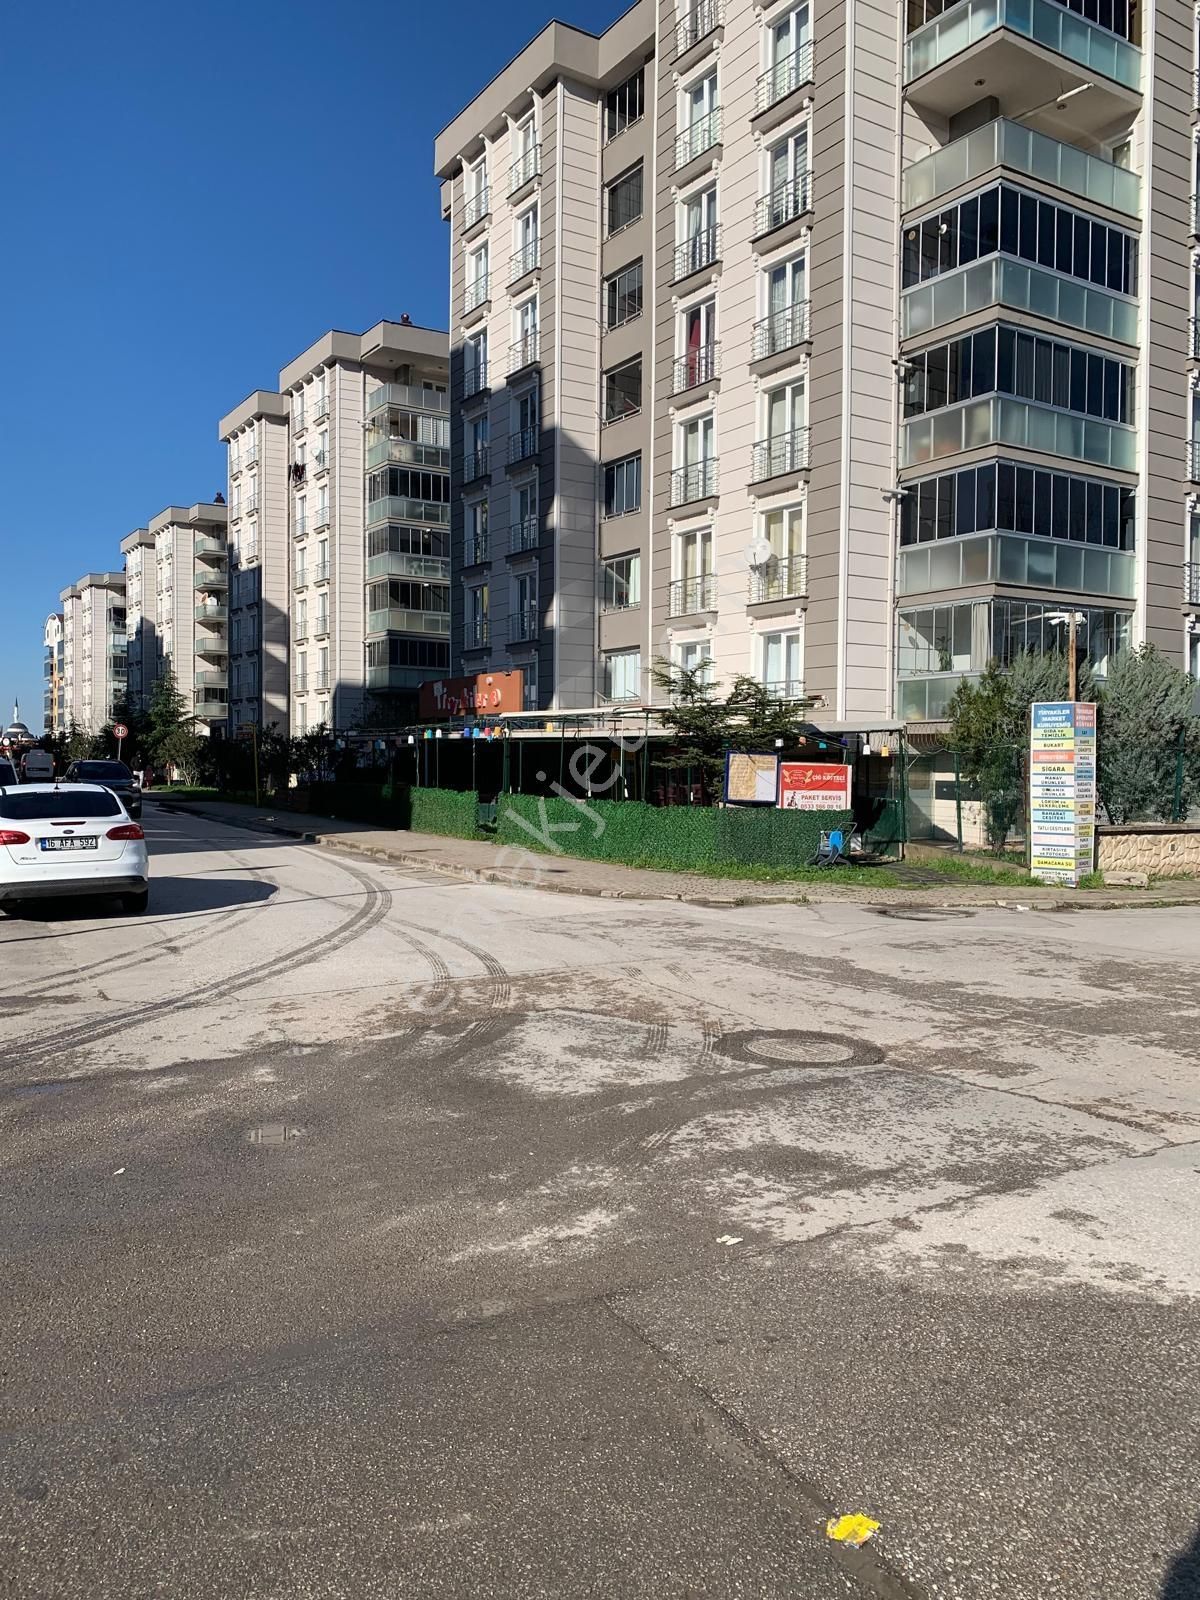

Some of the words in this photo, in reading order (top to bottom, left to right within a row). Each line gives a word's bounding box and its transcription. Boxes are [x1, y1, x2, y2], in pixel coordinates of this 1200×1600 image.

[116, 727, 125, 735] 30
[47, 839, 56, 848] 16
[59, 838, 75, 847] AFA
[79, 837, 94, 847] 592
